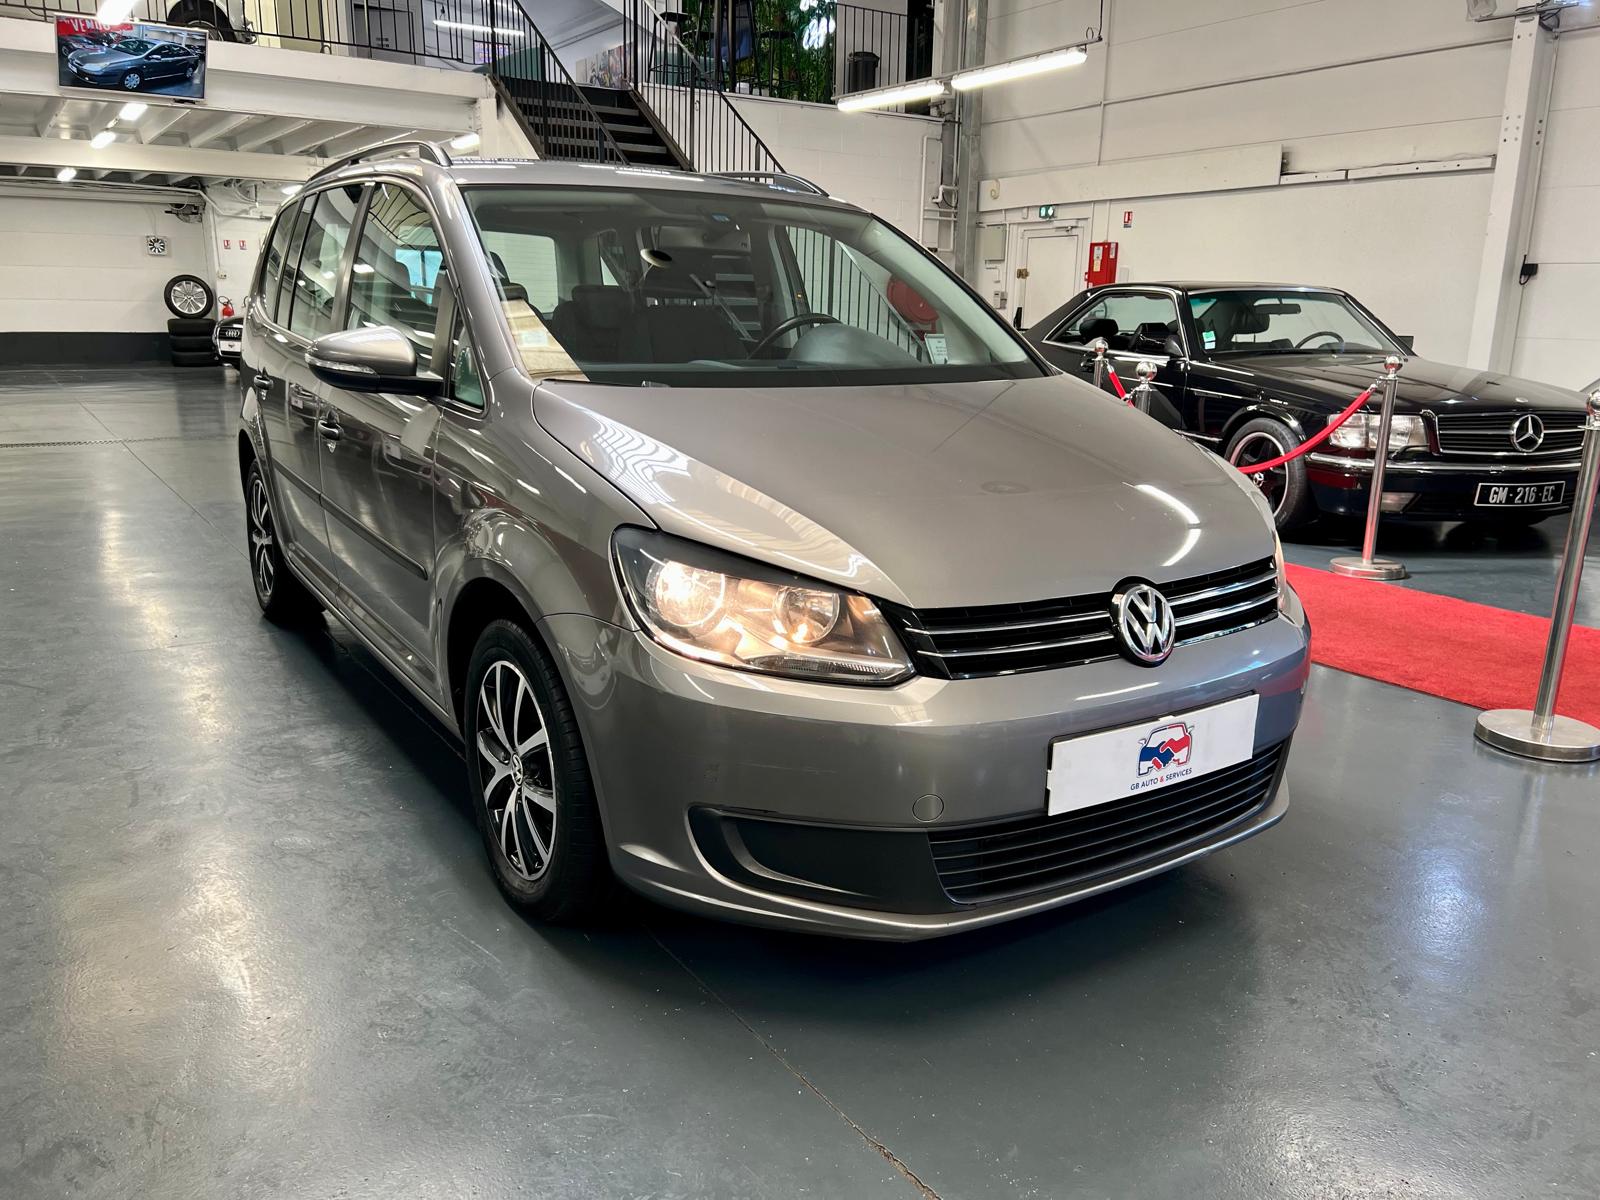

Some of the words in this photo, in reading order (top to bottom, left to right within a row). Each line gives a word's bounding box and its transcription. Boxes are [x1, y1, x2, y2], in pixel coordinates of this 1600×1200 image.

[1130, 782, 1140, 791] GB
[1140, 777, 1159, 789] AUTO
[1165, 767, 1193, 781] SERVICES
